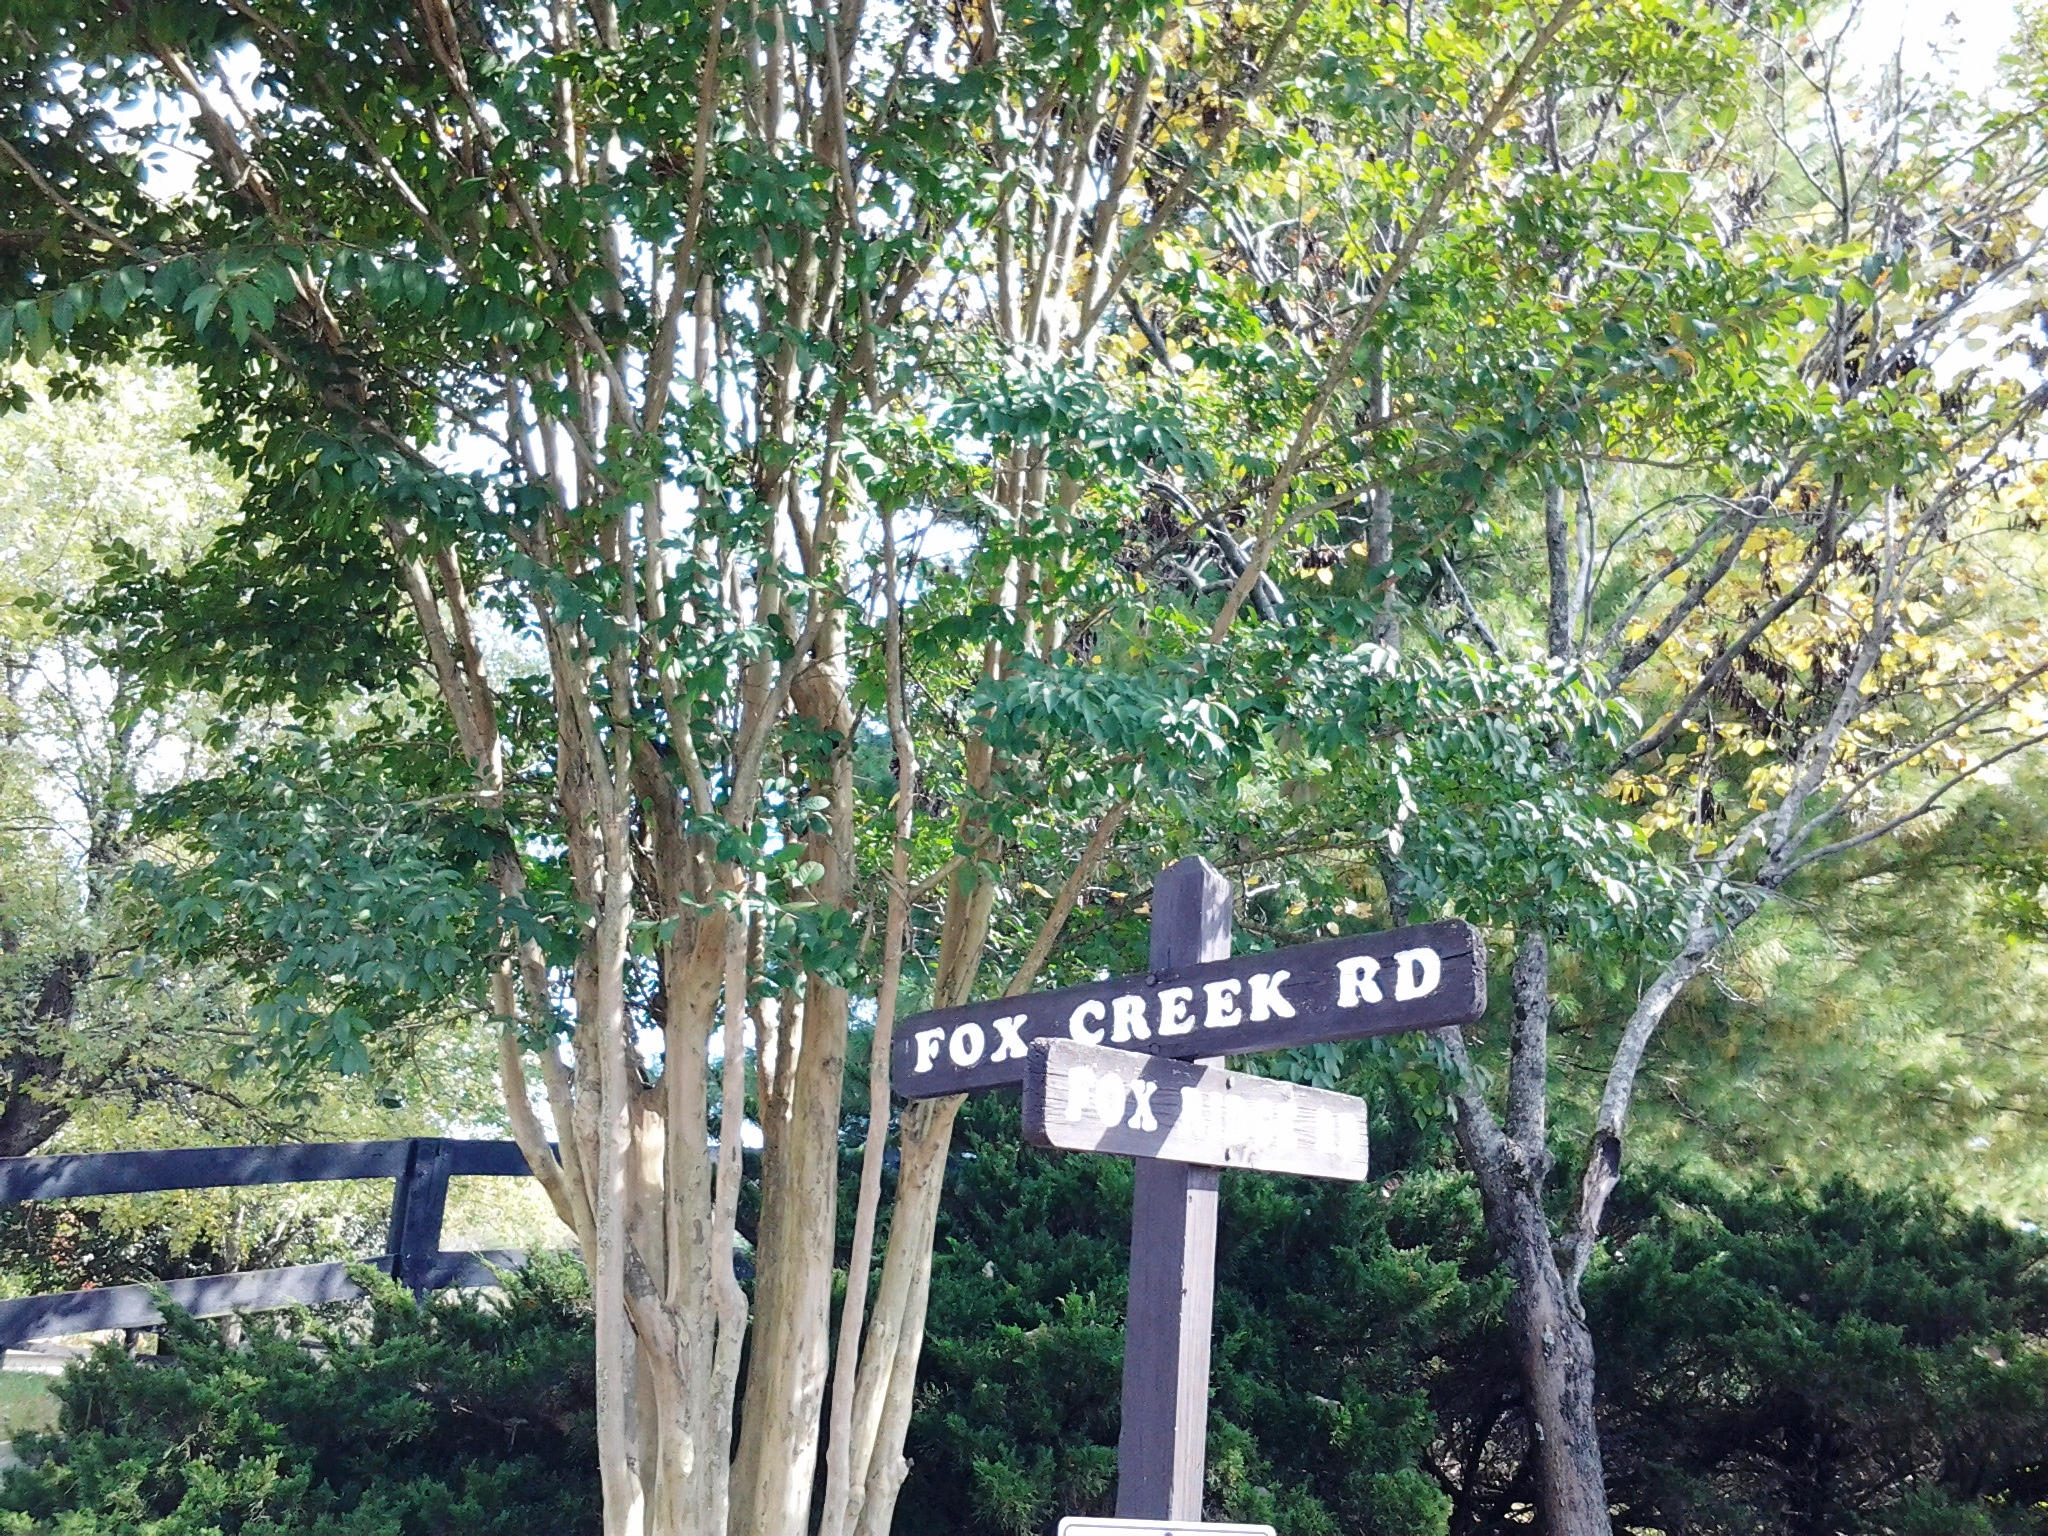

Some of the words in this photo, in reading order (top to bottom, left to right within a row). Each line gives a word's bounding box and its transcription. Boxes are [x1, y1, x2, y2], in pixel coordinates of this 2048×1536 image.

[913, 1014, 1029, 1074] FOX
[1068, 970, 1296, 1046] CREEK
[1335, 947, 1442, 1009] RD
[1065, 1065, 1158, 1132] FOX
